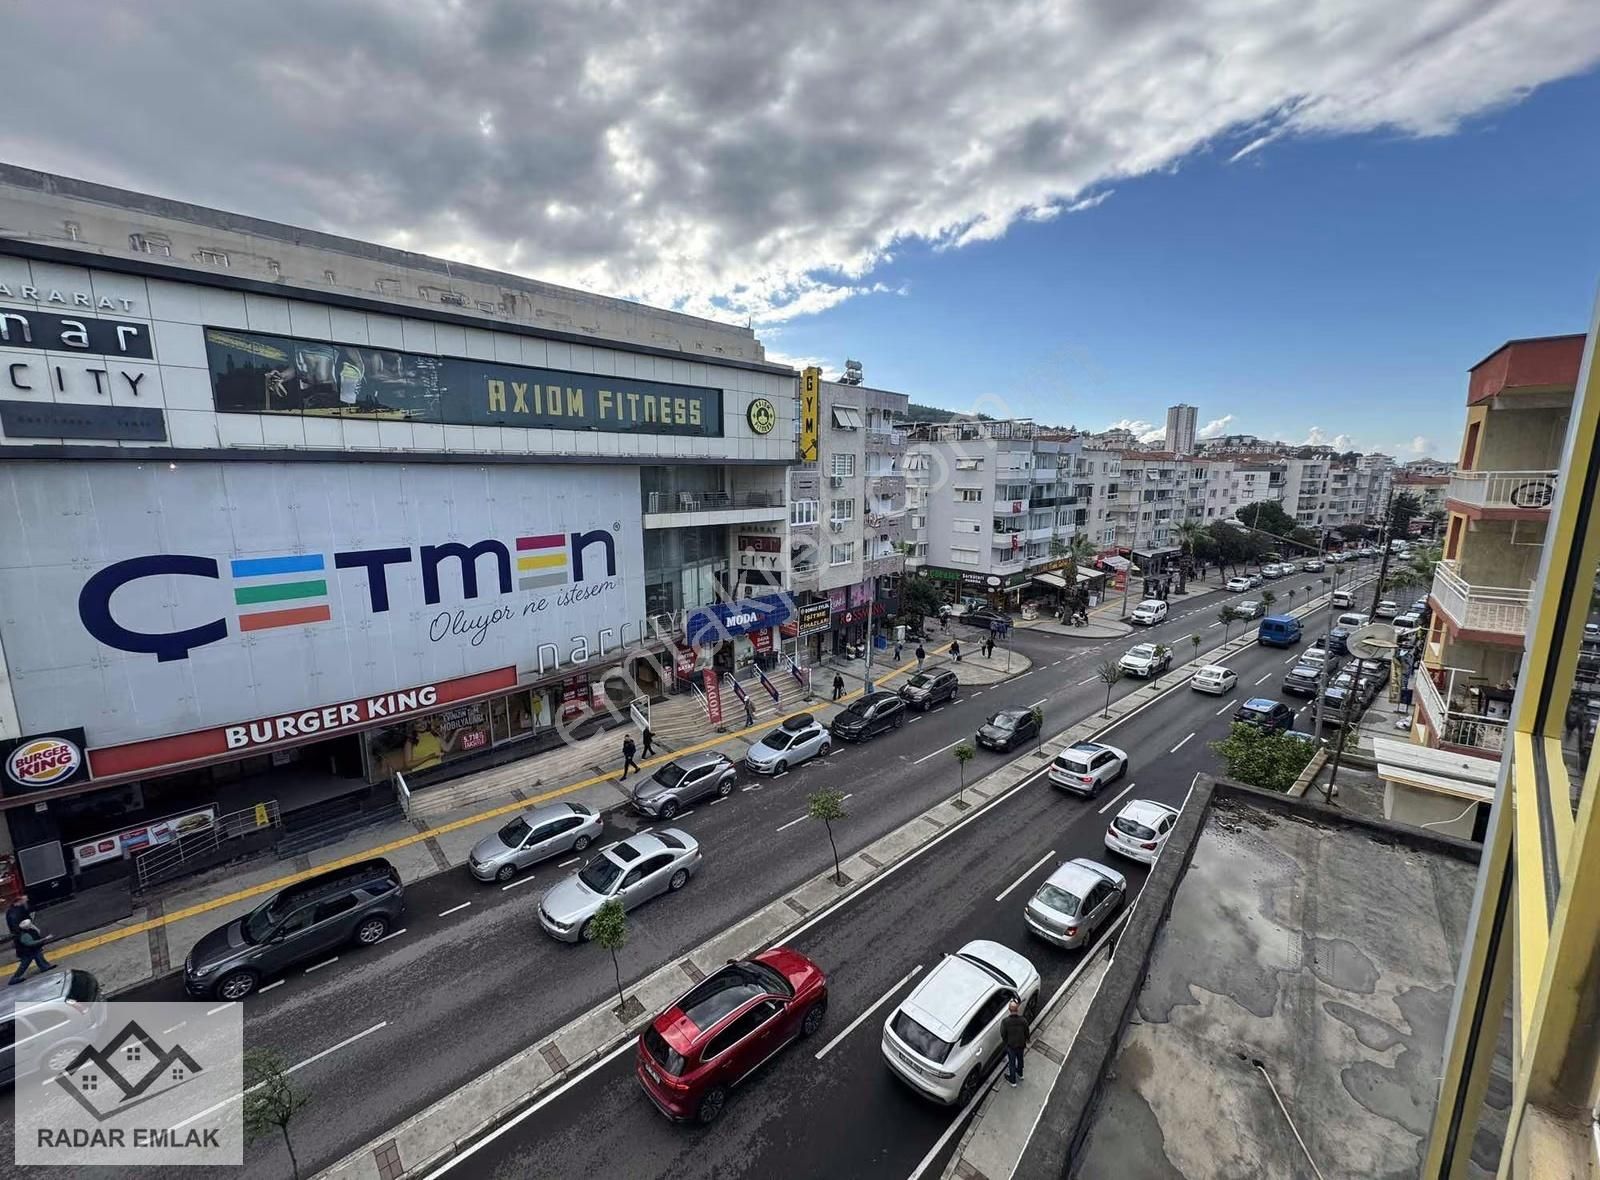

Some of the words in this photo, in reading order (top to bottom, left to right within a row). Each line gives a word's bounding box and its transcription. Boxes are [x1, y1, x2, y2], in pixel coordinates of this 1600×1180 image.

[9, 363, 145, 396] CITY
[487, 379, 585, 417] AXIOM
[598, 389, 703, 426] FITNESS
[805, 375, 814, 434] GYM
[741, 555, 777, 568] CITY
[429, 605, 515, 647] Oluyor
[522, 597, 550, 617] ne
[556, 578, 617, 607] istesem
[726, 612, 758, 628] MODA
[225, 704, 360, 750] BURGER
[368, 686, 437, 719] KING
[15, 745, 69, 769] BURGER
[19, 752, 72, 779] KING
